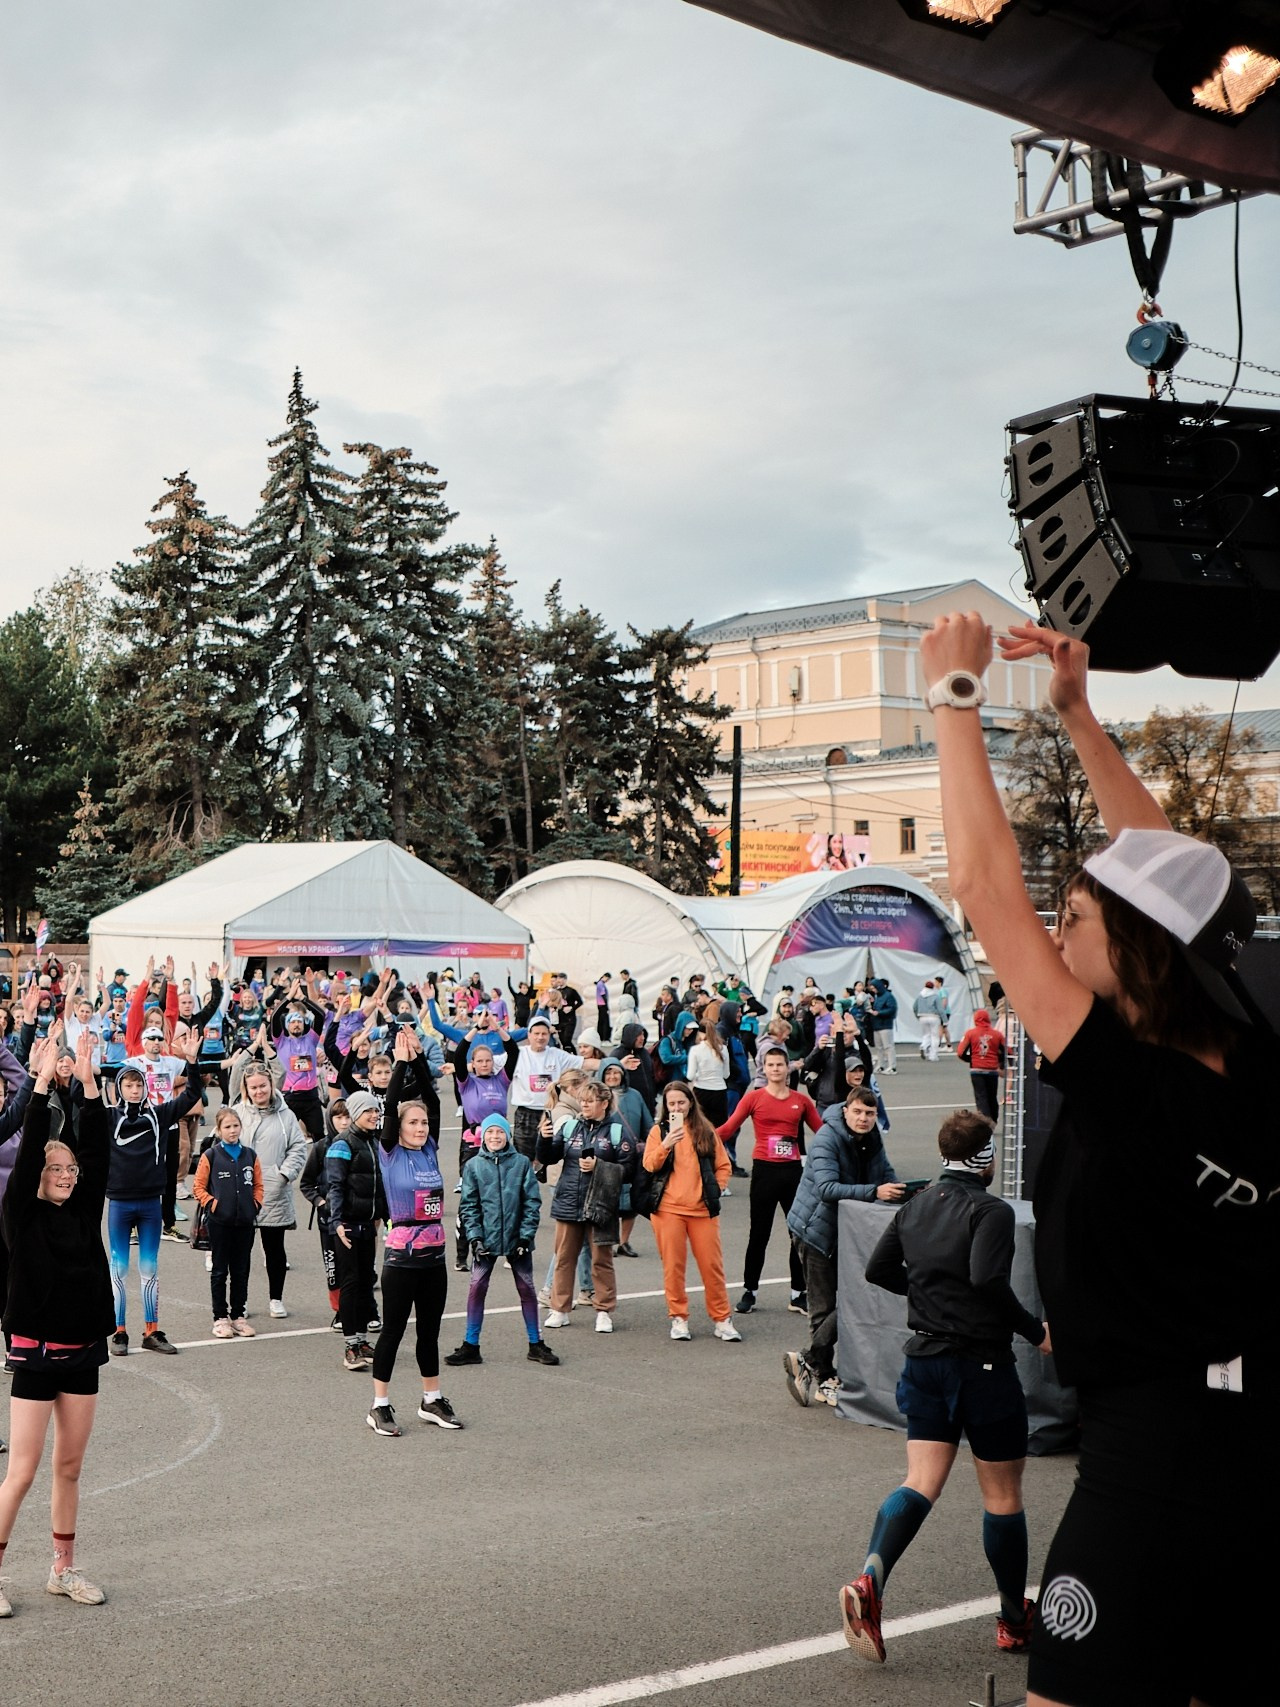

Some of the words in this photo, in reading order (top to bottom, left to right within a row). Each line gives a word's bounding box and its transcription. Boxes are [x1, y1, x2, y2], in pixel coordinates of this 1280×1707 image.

[741, 860, 802, 873] ИКИТИНСКИЙ!
[277, 945, 308, 954] КАМЕРА
[308, 945, 346, 954] ХРАНЕНИЯ
[450, 947, 470, 956] ШТАБ
[424, 1202, 441, 1216] 999
